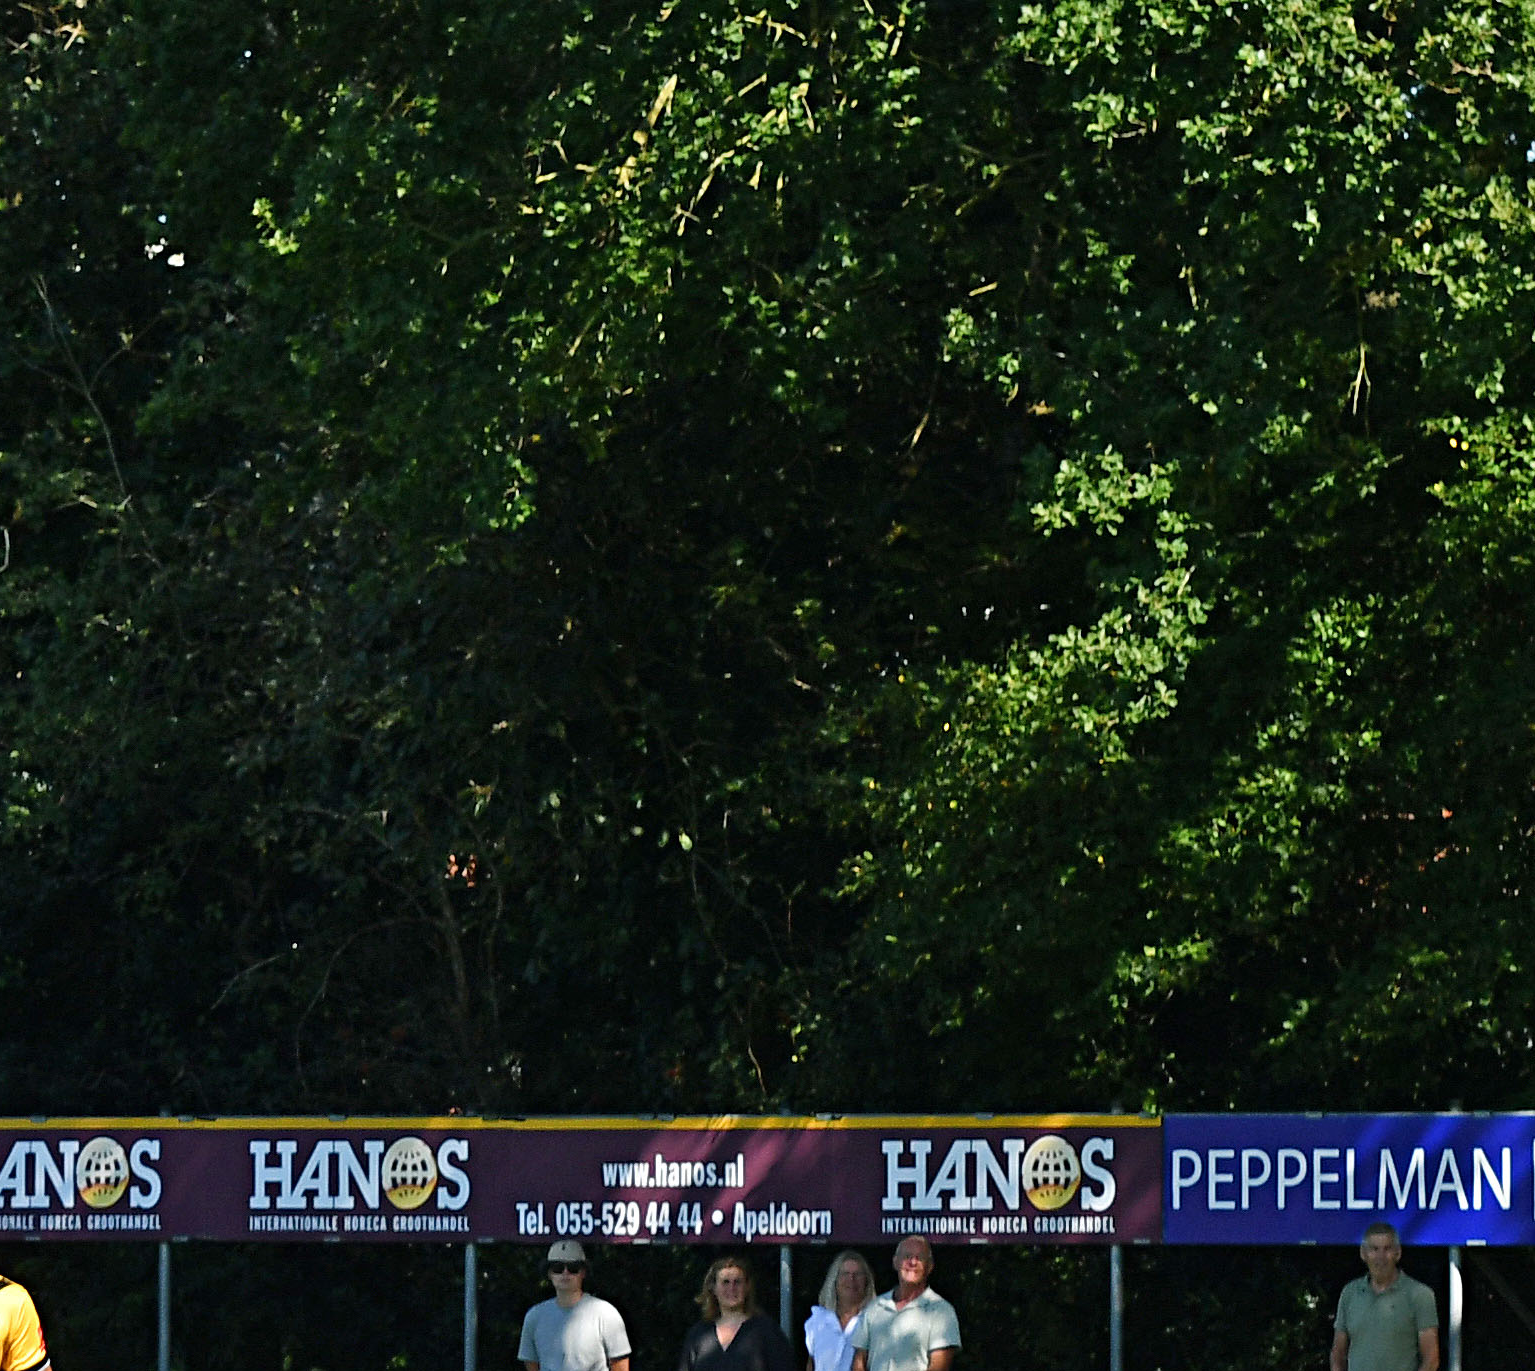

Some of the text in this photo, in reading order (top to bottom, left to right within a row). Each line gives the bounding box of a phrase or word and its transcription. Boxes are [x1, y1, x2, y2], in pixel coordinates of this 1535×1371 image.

[249, 1136, 471, 1211] HANOS
[602, 1153, 744, 1188] www.hanos.nl
[881, 1135, 1116, 1212] HANOS
[1172, 1147, 1511, 1210] PEPPELMAN
[40, 1214, 81, 1231] HORECA
[87, 1214, 162, 1232] GROOTHANDEL
[249, 1214, 470, 1233] INTERNATIONALE HORECA GROOTHANDEL
[516, 1201, 832, 1243] Tel. 055-529 44 44 Apeldoorn
[881, 1216, 1116, 1234] INTERNATIONALE HORECA GROOTHANDEL
